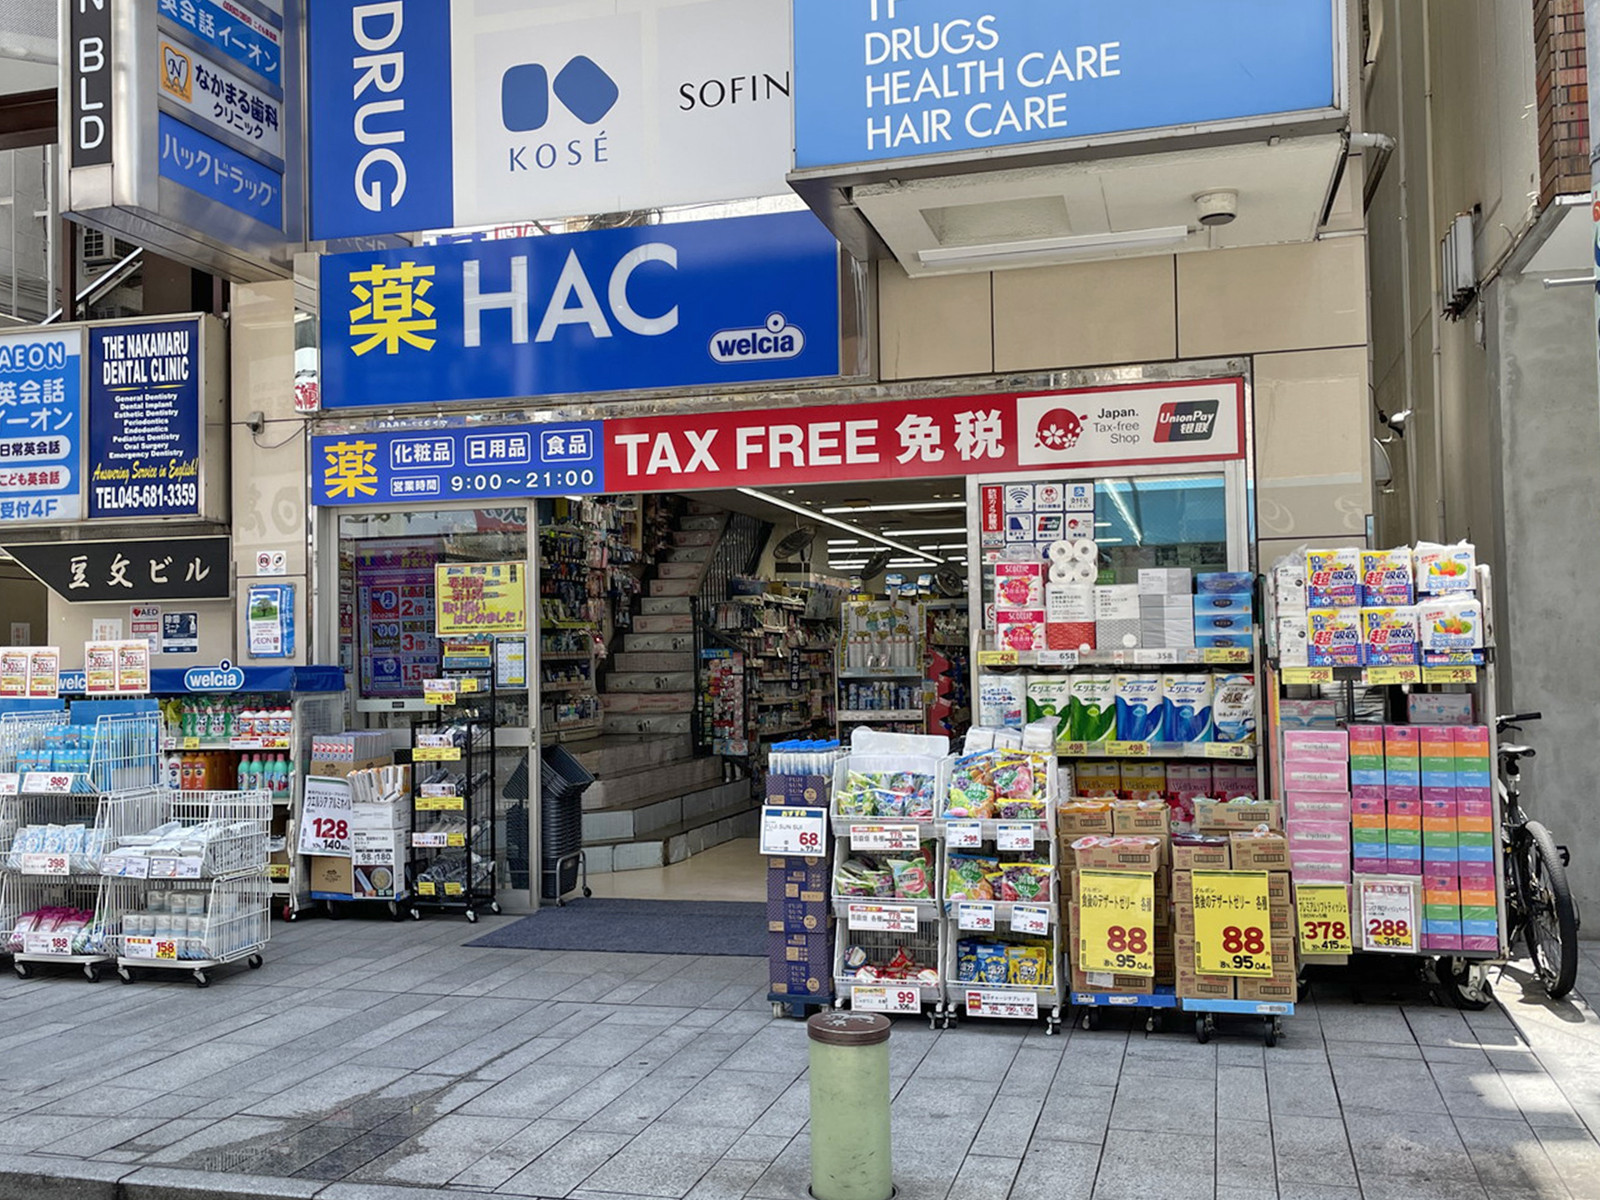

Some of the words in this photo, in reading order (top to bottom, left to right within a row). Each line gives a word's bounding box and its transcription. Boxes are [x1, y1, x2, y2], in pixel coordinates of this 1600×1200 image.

[865, 15, 999, 65] DRUGS
[866, 57, 1004, 108] HEALTH
[1016, 41, 1120, 87] CARE
[79, 37, 104, 149] BLD
[195, 64, 278, 131] なかまる歯科
[679, 72, 790, 111] SOFIN
[352, 1, 407, 212] DRUG
[213, 102, 263, 140] クリニック
[867, 109, 952, 150] HAIR
[965, 93, 1067, 138] CARE
[508, 131, 609, 172] KOSÉ
[163, 134, 277, 207] ハックドラッグ
[463, 243, 679, 347] HAC
[349, 262, 437, 356] 薬
[102, 335, 125, 359] THE
[127, 330, 189, 358] NAKAMARU
[716, 332, 795, 356] welcia
[0, 345, 63, 369] AEON
[103, 359, 148, 385] DENTAL
[151, 356, 189, 382] CLINIC
[0, 378, 65, 406] 英会話
[115, 394, 143, 403] General
[1098, 408, 1139, 420] Japan.
[1160, 411, 1214, 427] UnionPay
[1093, 421, 1140, 432] Tax-free
[0, 440, 60, 457] 日常英会話
[470, 439, 525, 459] 日用品
[547, 435, 586, 456] 食品
[615, 429, 721, 476] TAX
[736, 420, 879, 470] FREE
[895, 410, 1005, 464] 免税
[1110, 434, 1140, 445] Shop
[394, 442, 450, 464] 化粧品
[324, 441, 378, 498] 薬
[392, 478, 437, 492] 営業時間
[96, 483, 196, 509] TEL045-681-3359
[0, 499, 58, 519] 受付4F
[1060, 652, 1075, 661] 658
[190, 671, 236, 687] welcia
[1310, 671, 1328, 679] 228
[1399, 671, 1416, 680] 198
[1451, 670, 1472, 679] 238
[1031, 685, 1065, 693] エリエール
[1076, 685, 1110, 693] エリエール
[50, 777, 68, 786] 980
[313, 818, 348, 839] 128
[323, 840, 341, 849] 140
[799, 832, 818, 845] 68
[48, 859, 65, 867] 398
[1082, 893, 1135, 909] 食後のデザートゼリー
[1194, 894, 1250, 909] 食後のデザートゼリー
[1304, 921, 1346, 939] 378
[1369, 919, 1407, 937] 288
[52, 938, 67, 948] 188
[156, 942, 174, 953] 158
[1107, 925, 1147, 954] 88
[1222, 926, 1265, 954] 88
[1322, 941, 1339, 949] 415
[1384, 937, 1400, 946] 316
[897, 992, 914, 1003] 99
